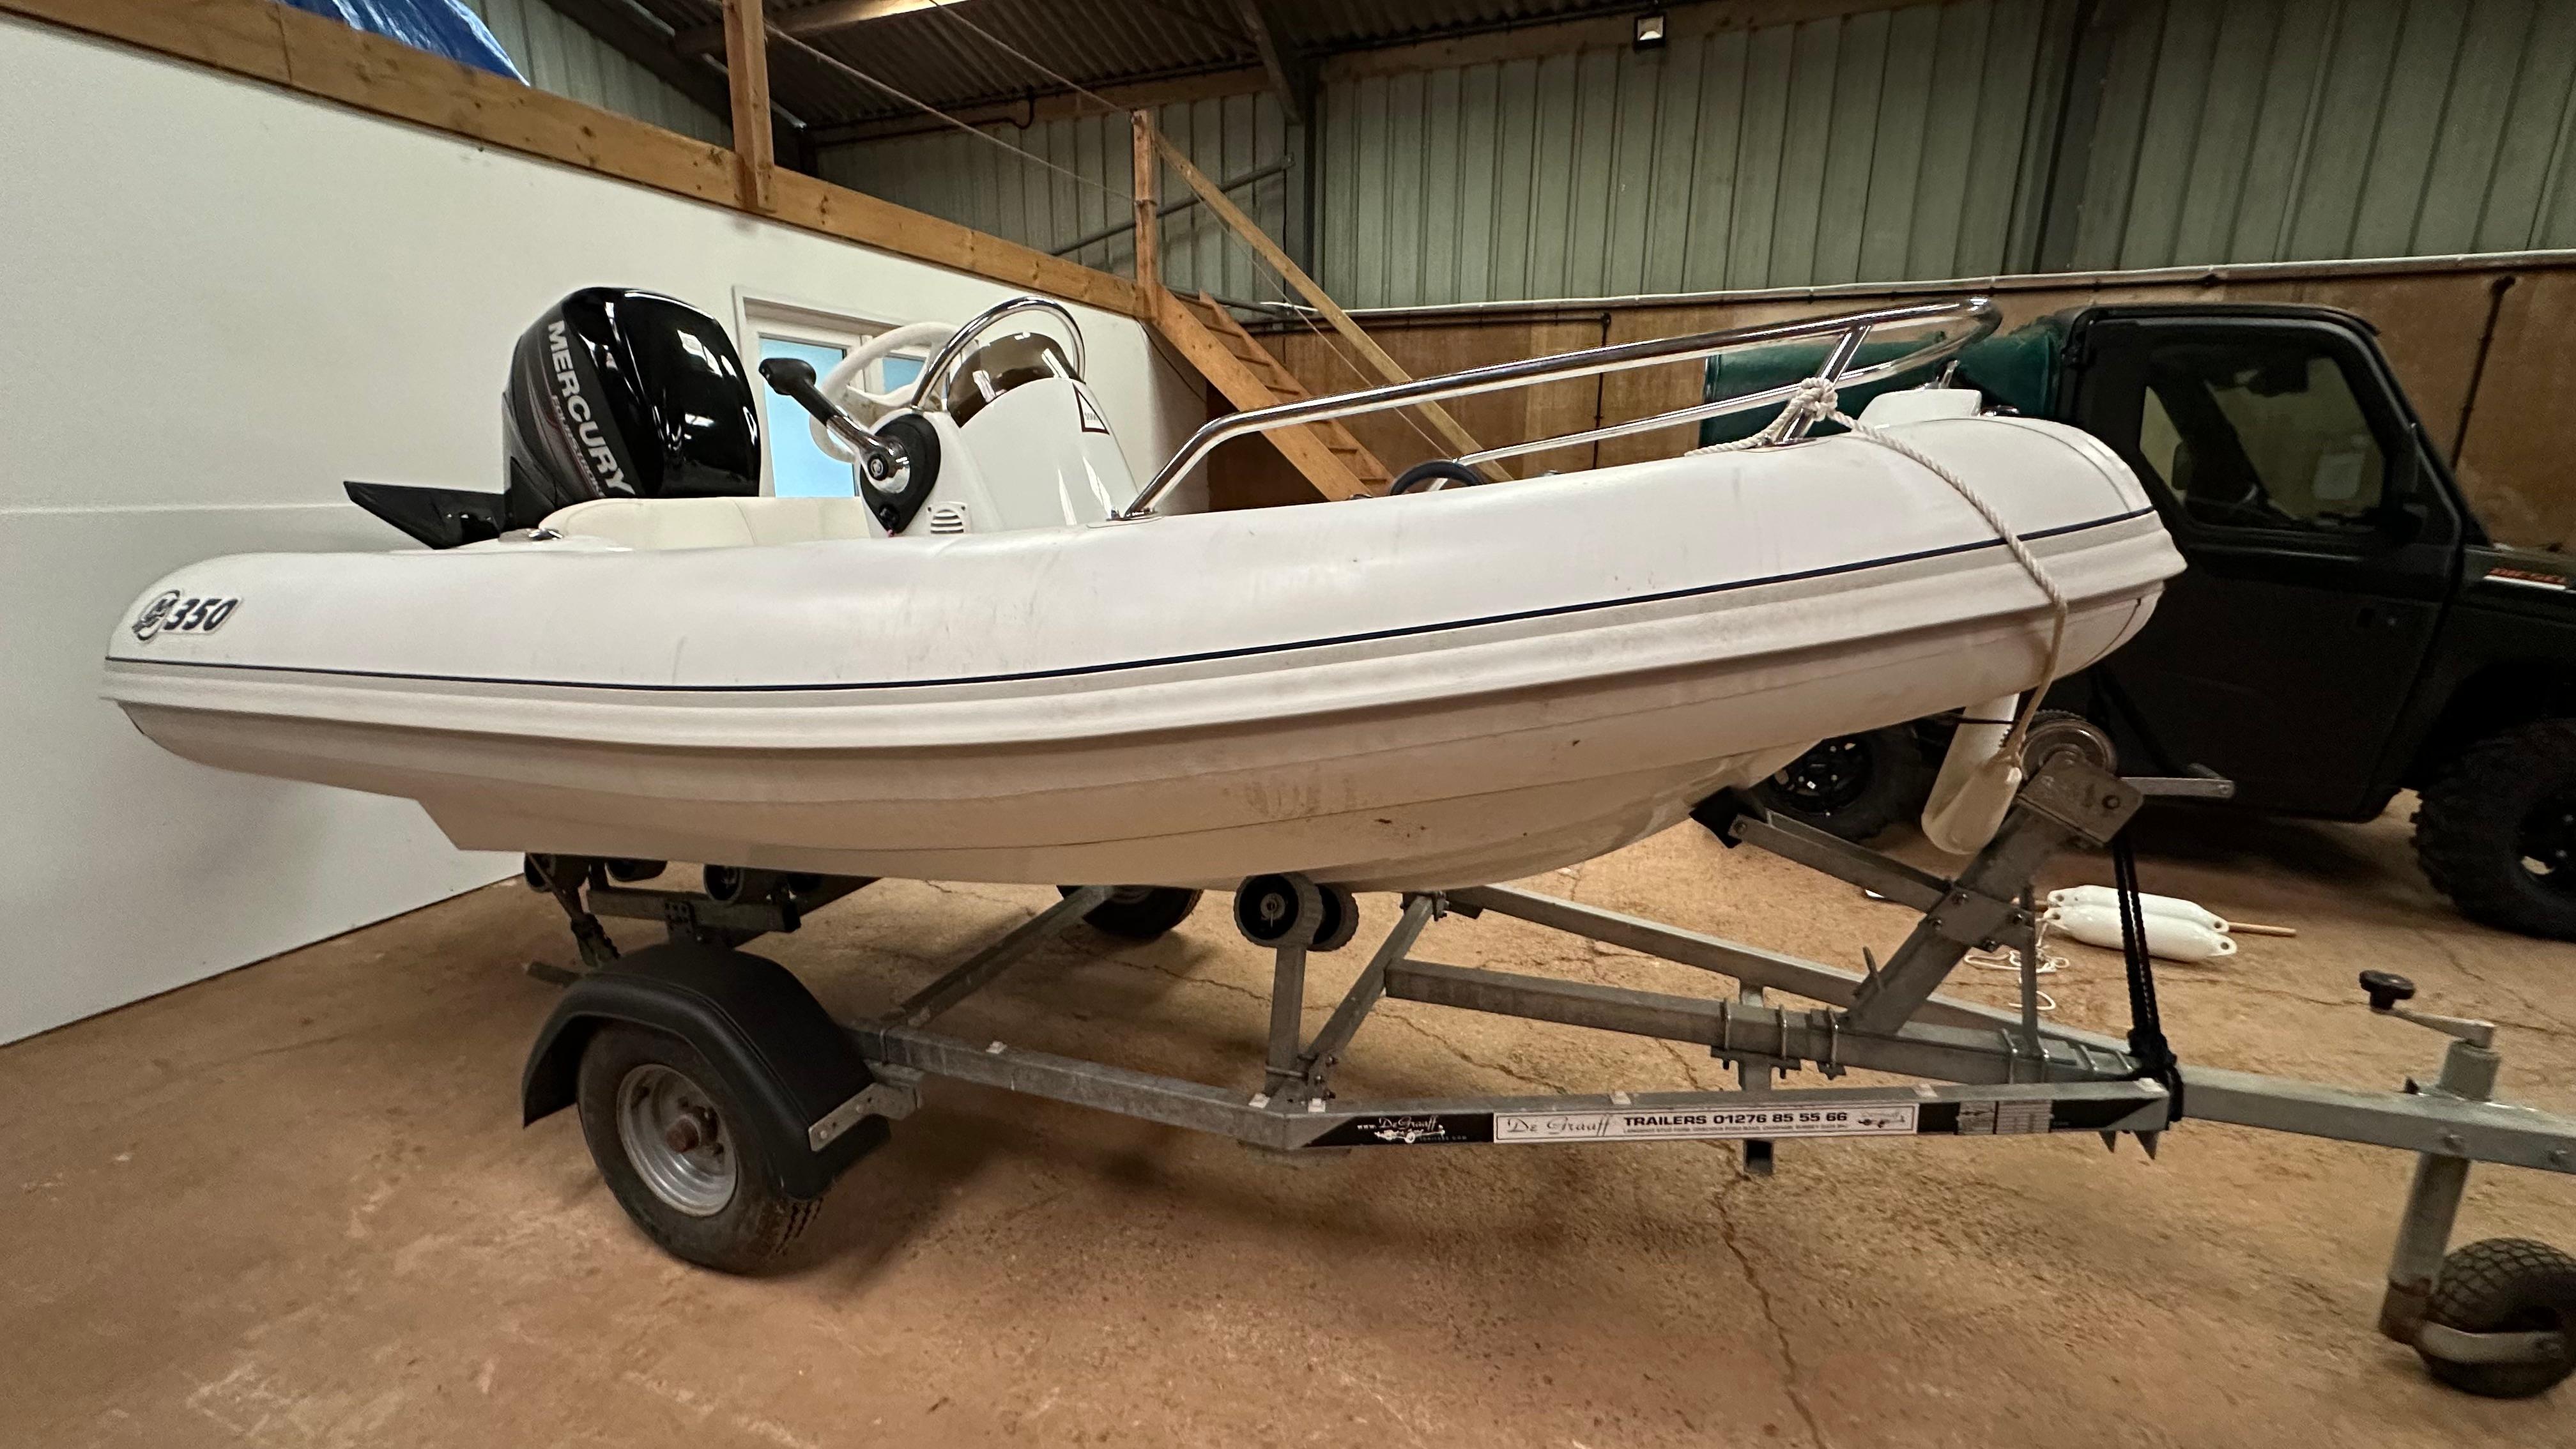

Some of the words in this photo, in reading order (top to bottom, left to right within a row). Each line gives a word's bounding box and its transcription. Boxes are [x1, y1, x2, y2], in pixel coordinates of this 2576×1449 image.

[548, 319, 636, 495] MERCURY
[163, 598, 238, 631] 350
[1623, 1115, 1706, 1126] TRAILERS
[1713, 1114, 1767, 1124] 01276
[1772, 1113, 1794, 1123] 85
[1799, 1112, 1820, 1122] 55
[1826, 1112, 1848, 1121] 66
